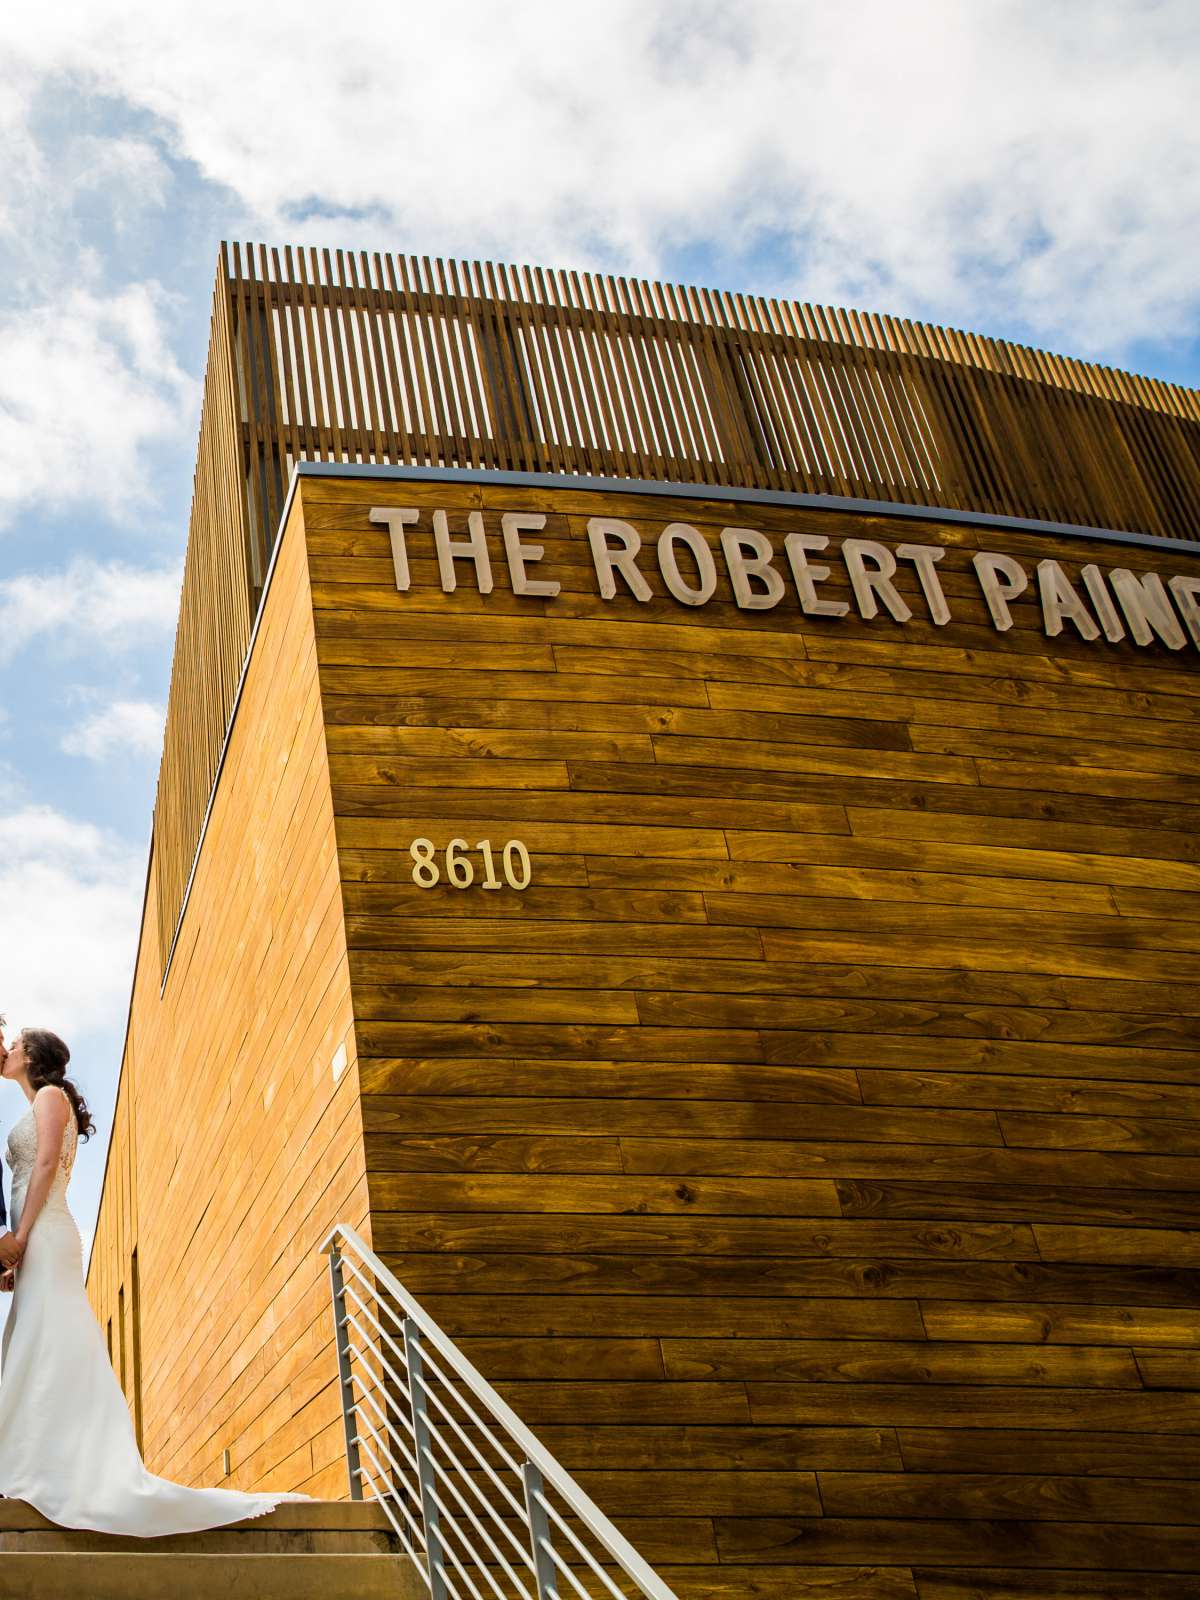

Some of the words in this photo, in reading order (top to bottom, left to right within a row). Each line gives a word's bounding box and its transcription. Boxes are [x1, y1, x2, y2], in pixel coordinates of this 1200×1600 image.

[369, 507, 561, 597] THE
[587, 518, 952, 626] ROBERT
[410, 838, 532, 891] 8610
